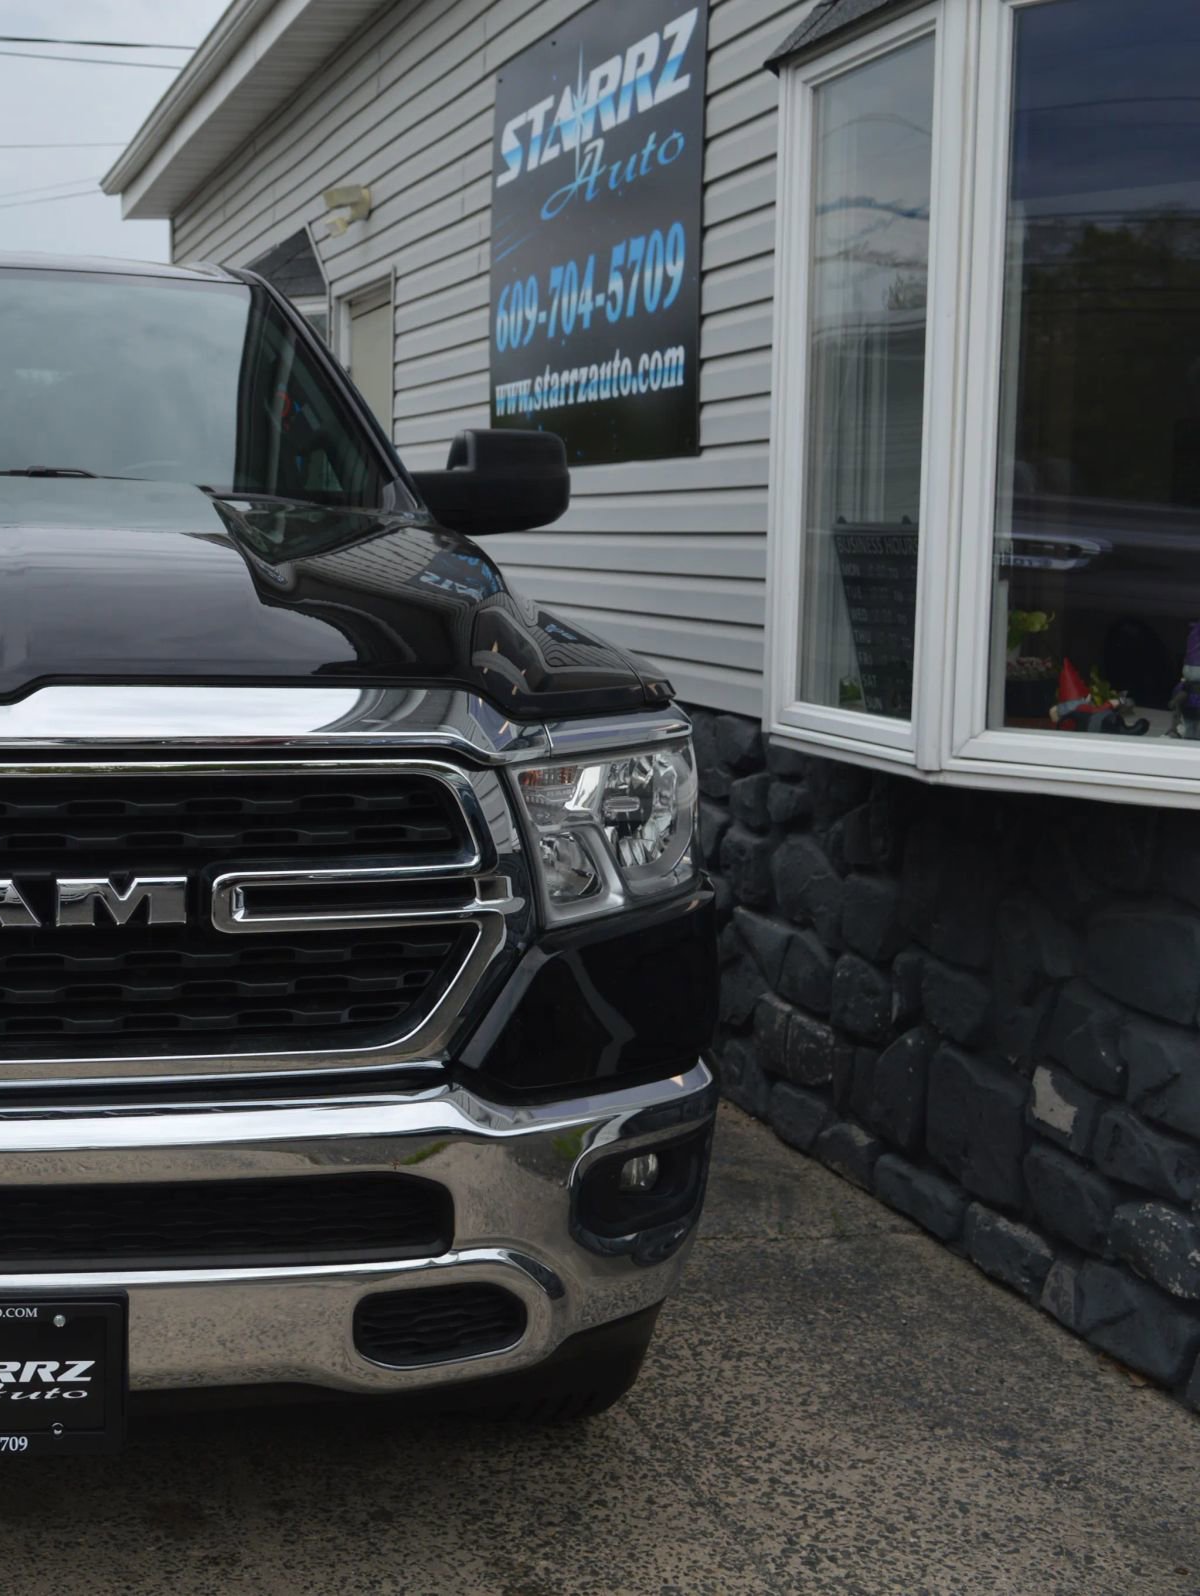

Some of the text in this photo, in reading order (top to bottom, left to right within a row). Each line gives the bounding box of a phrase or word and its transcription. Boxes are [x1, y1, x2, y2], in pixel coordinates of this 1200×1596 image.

[496, 8, 698, 187] STARRZ
[540, 130, 685, 221] Auto
[495, 222, 686, 352] 609-704-5709
[495, 345, 685, 417] www.starrzauto.com
